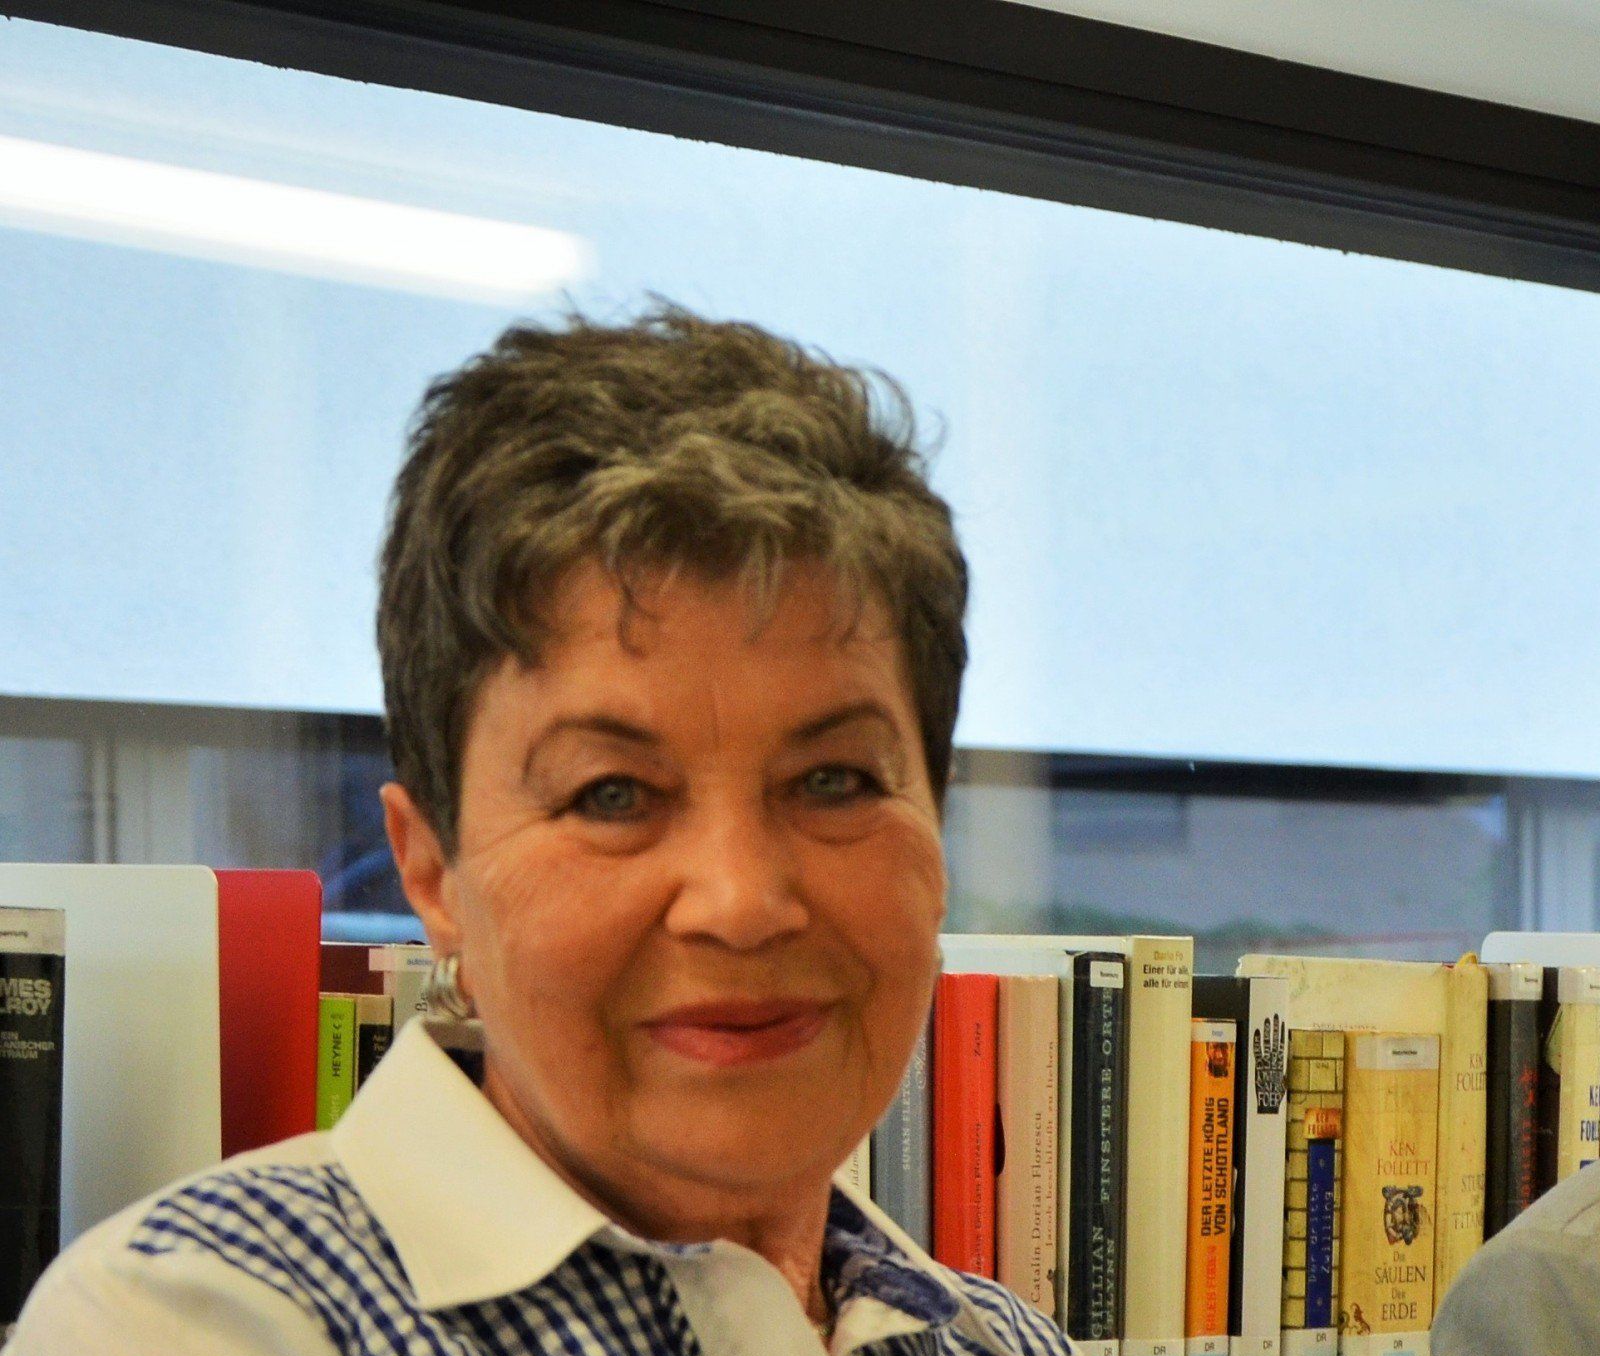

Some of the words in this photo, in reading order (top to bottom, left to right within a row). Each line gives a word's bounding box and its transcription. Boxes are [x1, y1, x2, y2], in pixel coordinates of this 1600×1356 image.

[1143, 964, 1165, 975] Einer
[1143, 979, 1160, 989] alle
[332, 1033, 342, 1078] HEYNE
[1101, 1068, 1112, 1202] FINSTERE
[1203, 1097, 1215, 1143] KÖNIG
[902, 1128, 911, 1170] SUSAN
[1032, 1112, 1042, 1178] Florescu
[1215, 1097, 1229, 1201] SCHOTTLAND
[1389, 1140, 1416, 1157] KEN
[1202, 1150, 1213, 1201] LETZTE
[1376, 1158, 1430, 1176] FOLLETT
[1031, 1186, 1042, 1240] Dorian
[1201, 1204, 1212, 1237] DER
[1214, 1204, 1226, 1236] VON
[1321, 1191, 1334, 1274] Zwilling
[1031, 1247, 1042, 1303] Catalin
[1092, 1227, 1104, 1338] GILLIAN
[1103, 1238, 1115, 1328] FLYNN
[1374, 1262, 1427, 1285] SÄULEN
[1381, 1302, 1418, 1321] ERDE
[1153, 1346, 1166, 1356] DR
[1204, 1342, 1215, 1352] DR
[1262, 1339, 1273, 1350] DR
[1315, 1332, 1327, 1343] DR
[1393, 1339, 1403, 1350] DR
